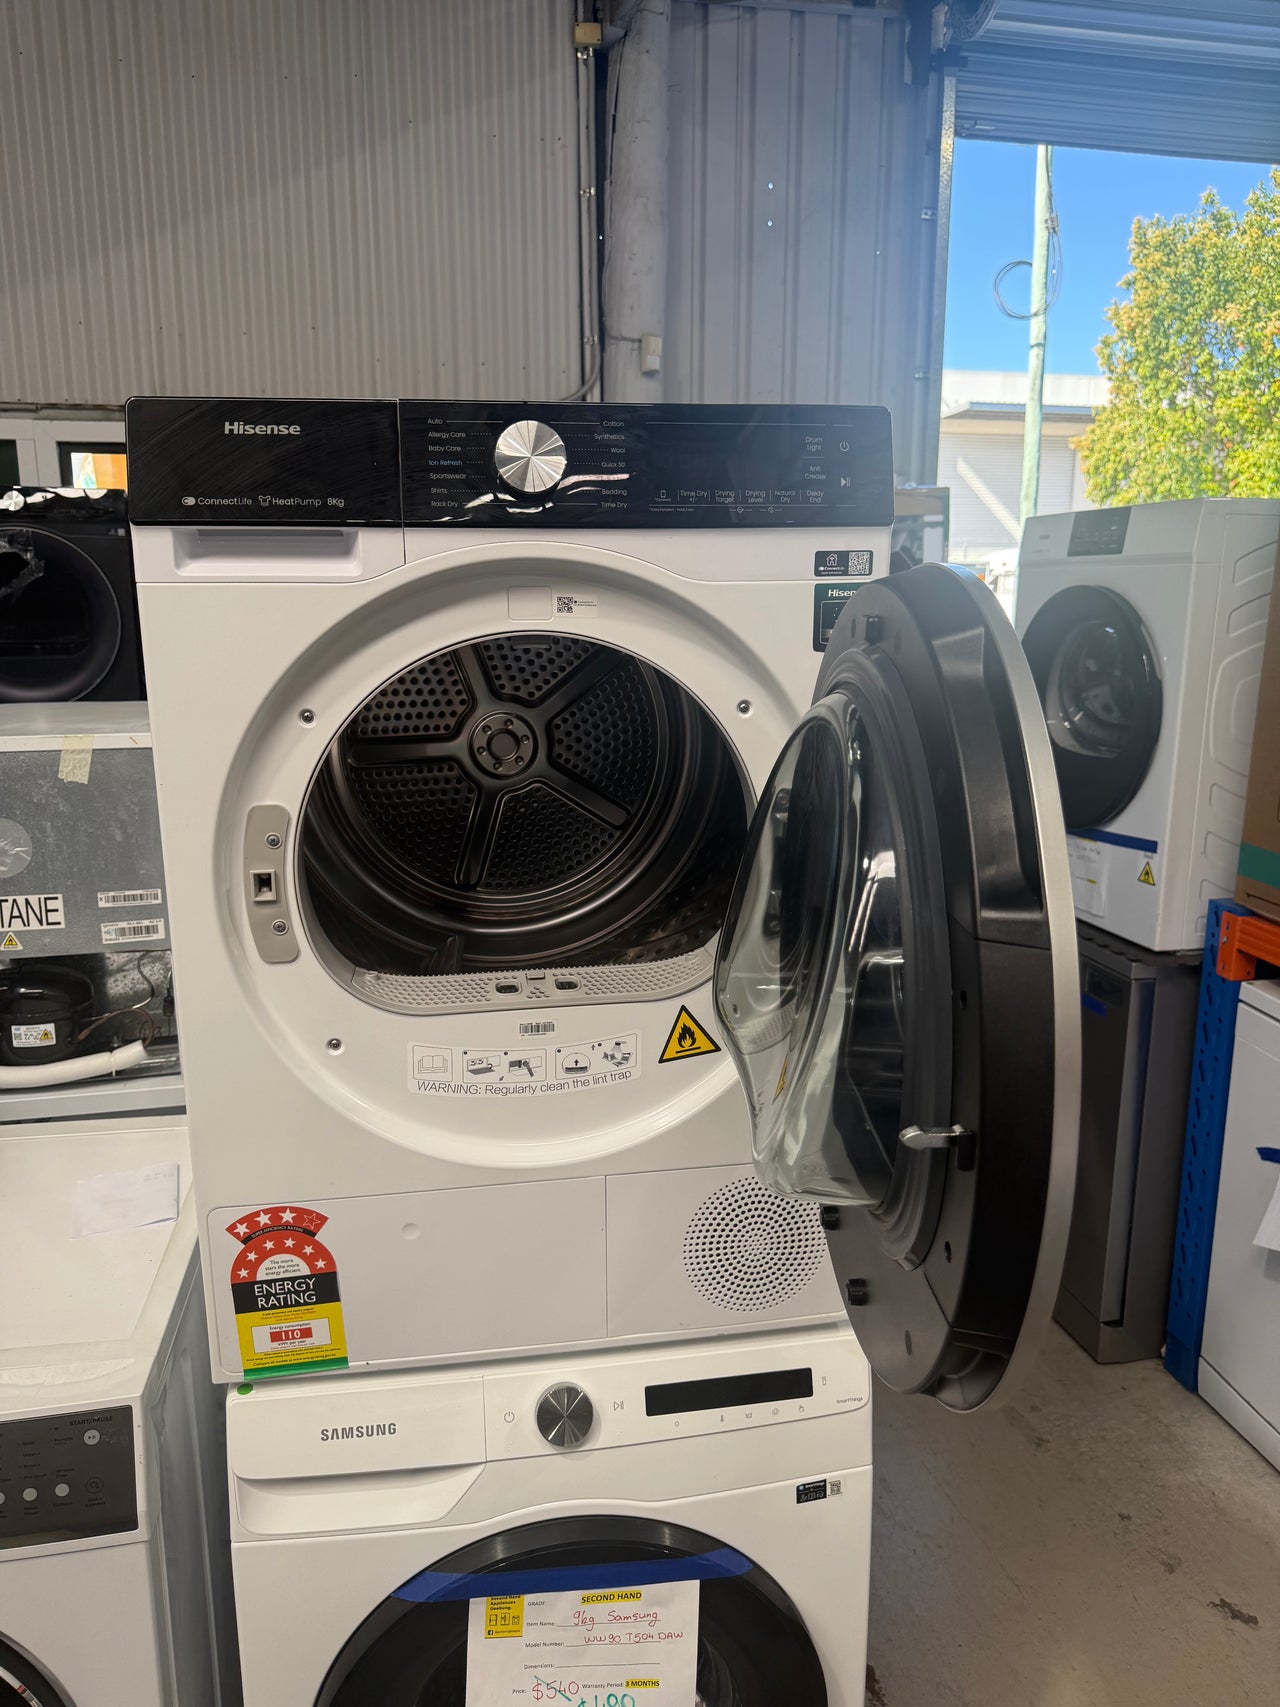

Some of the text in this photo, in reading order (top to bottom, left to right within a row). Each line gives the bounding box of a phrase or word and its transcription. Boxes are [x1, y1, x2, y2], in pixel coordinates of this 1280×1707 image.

[427, 417, 443, 425] Auto
[224, 421, 301, 435] Hisense
[428, 431, 451, 439] Allergy
[594, 433, 625, 441] Synthetics
[428, 445, 447, 453] Baby
[806, 443, 822, 452] Light
[601, 461, 616, 469] Quick
[429, 472, 467, 480] Sportswear
[601, 488, 628, 496] Bedding
[696, 490, 708, 498] Dry
[714, 490, 735, 498] Drying
[745, 490, 766, 498] Drying
[806, 490, 825, 498] Delay
[197, 496, 252, 505] ConnectLife
[272, 496, 322, 507] HeatPump
[327, 497, 345, 507] 8Kg
[714, 496, 735, 504] Target
[747, 496, 764, 504] Level
[780, 496, 791, 504] Dry
[430, 500, 458, 509] Rack Dry
[615, 501, 628, 509] Dry
[0, 896, 61, 928] TANE
[417, 1069, 632, 1097] WARNING: Regularly clean the lint trap
[265, 1269, 282, 1277] energy
[254, 1277, 317, 1297] ENERGY
[257, 1290, 317, 1309] RATING
[282, 1330, 301, 1340] 110
[835, 1396, 863, 1405] SmartThings
[69, 1416, 113, 1426] START/PAUSE
[320, 1422, 397, 1442] SAMSUNG
[581, 1592, 642, 1604] SECOND HAND
[573, 1610, 595, 1632] 9kg
[607, 1610, 658, 1627] Samsung
[542, 1640, 565, 1648] Number:
[523, 1662, 555, 1670] Dimensions:
[531, 1679, 580, 1702] $540
